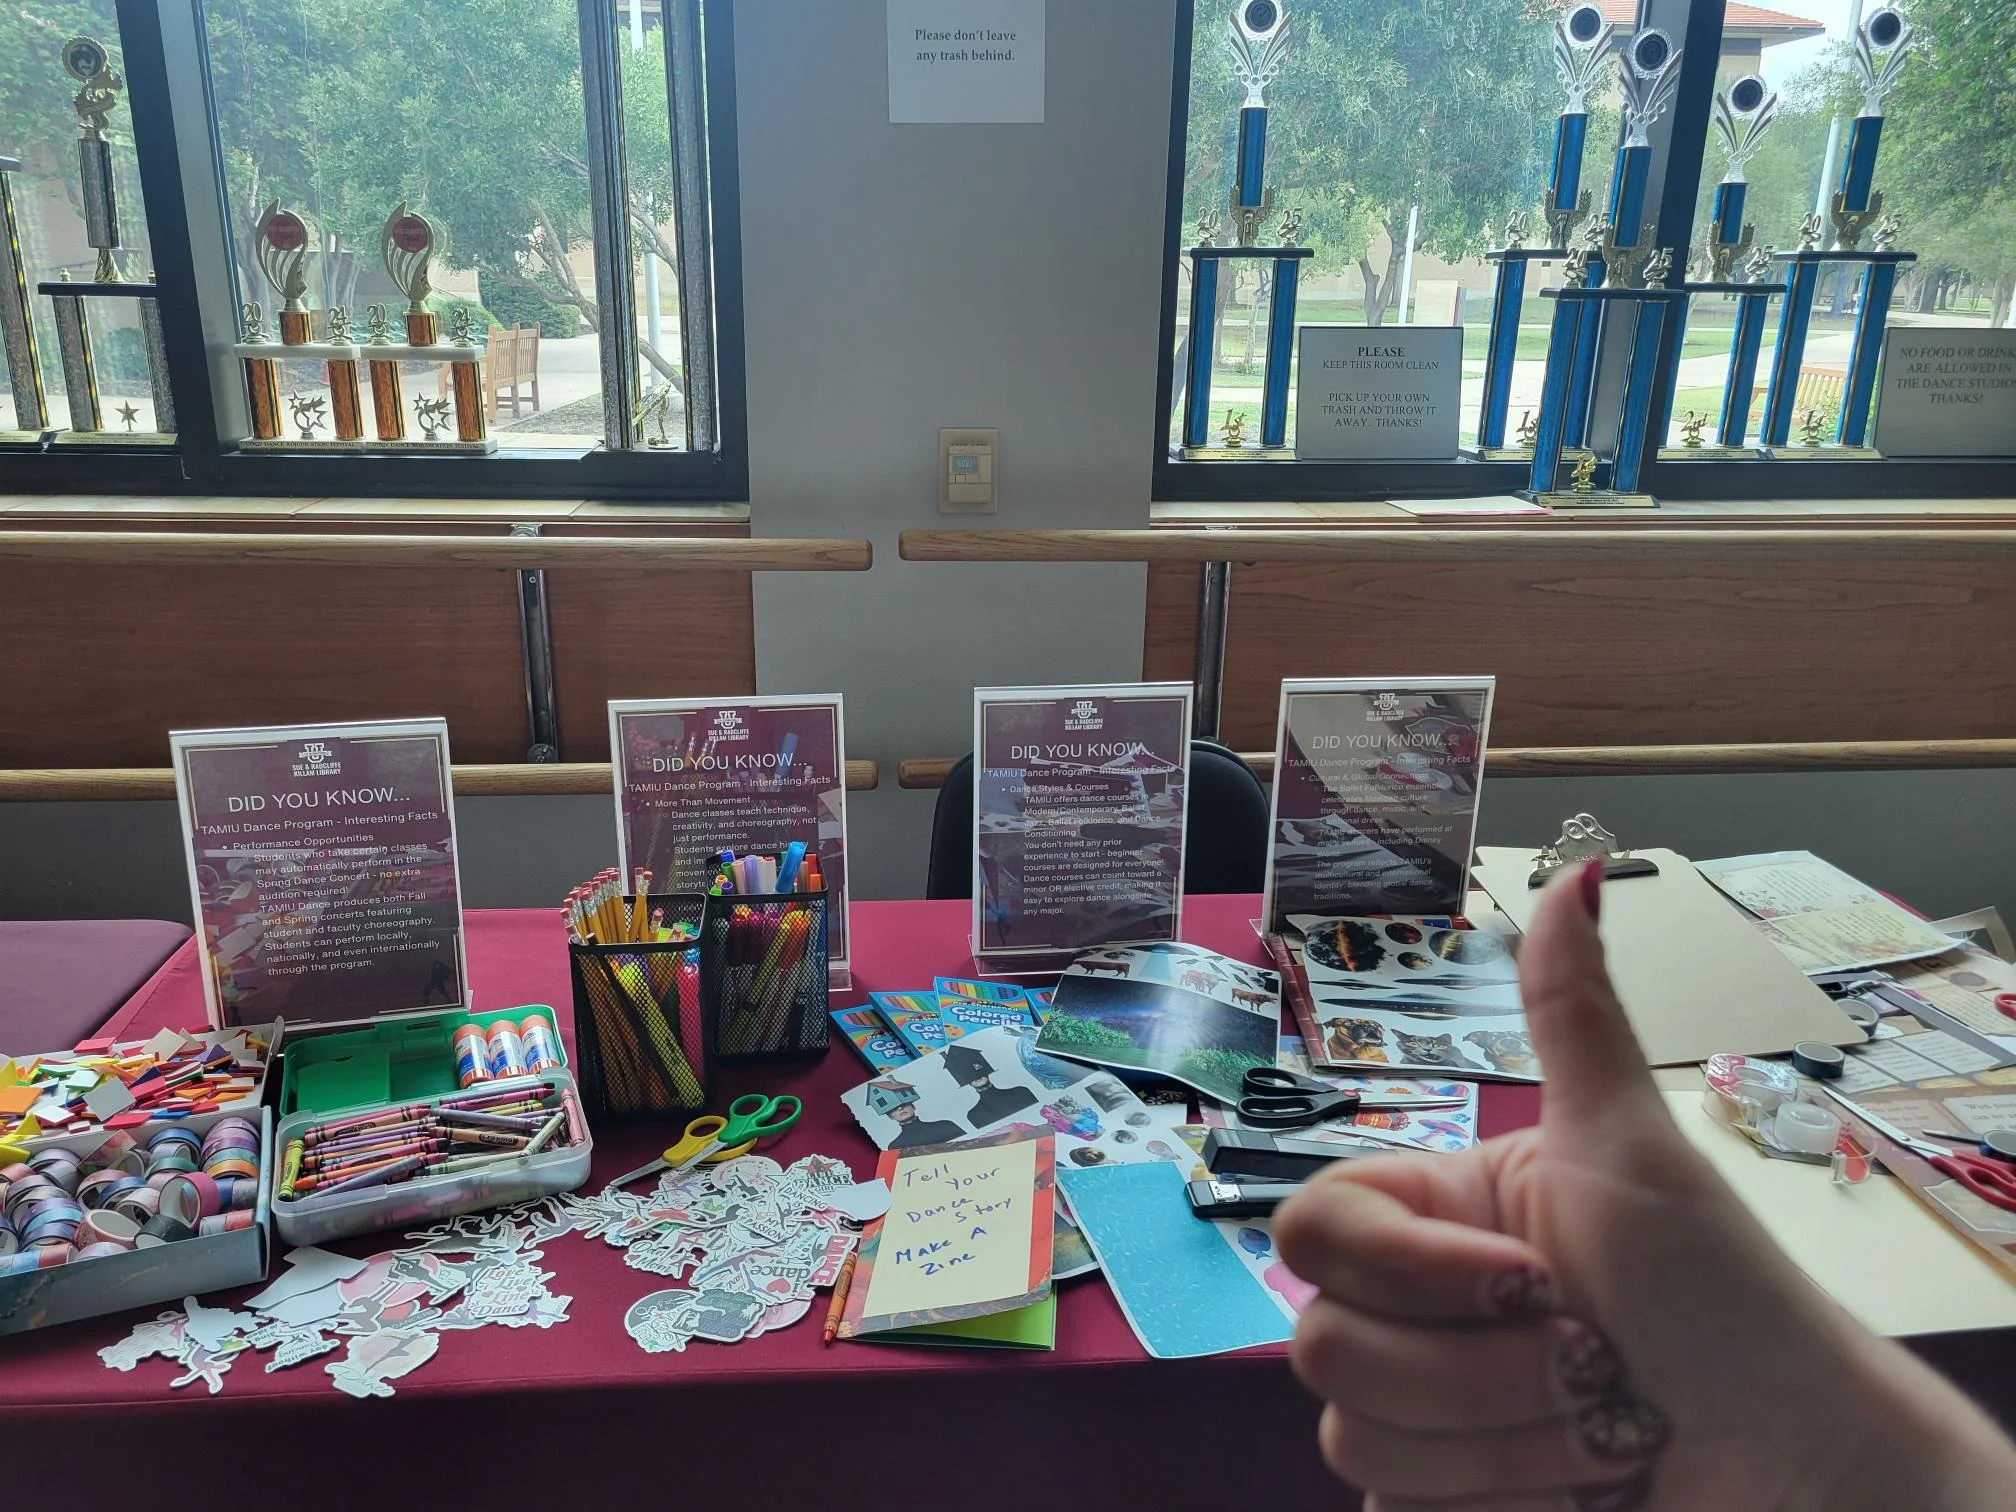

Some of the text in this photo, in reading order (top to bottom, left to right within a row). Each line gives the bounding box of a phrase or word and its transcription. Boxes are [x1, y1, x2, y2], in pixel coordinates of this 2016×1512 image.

[915, 29, 950, 41] Please
[987, 29, 1016, 41] leave
[917, 50, 1015, 63] any trash behind.
[243, 302, 263, 325] 20
[329, 305, 348, 327] 24
[367, 303, 387, 323] 20
[453, 307, 471, 327] 24
[1358, 347, 1406, 357] PLEASE
[1900, 347, 1917, 358] NO
[1920, 348, 1955, 358] FOOD
[1958, 348, 1974, 358] OR
[1323, 361, 1439, 370] KEEP THIS ROOM CLEAN
[1906, 363, 2012, 373] ARE ALLOWED IN
[1896, 378, 1921, 389] THE
[1922, 379, 1966, 389] DANCE
[1329, 393, 1430, 402] PICK UP YOUR OWN
[1322, 406, 1436, 415] TRASH AND THROW IT
[1334, 418, 1422, 428] AWAY. THANKS!
[1313, 736, 1340, 749] DID
[1347, 734, 1382, 748] YOU
[1011, 746, 1040, 759] DID
[1045, 744, 1082, 758] YOU
[653, 753, 807, 772] DID YOU KNOW...
[317, 768, 341, 776] LIBRARY
[629, 776, 831, 792] TAMIU Dance Program Interesting Facts
[228, 787, 410, 812] DID YOU KNOW...
[655, 796, 751, 808] More Than Movement
[200, 811, 437, 835] TAMIU Dance Program Interesting Facts
[718, 819, 735, 828] and
[803, 816, 816, 824] not
[233, 834, 374, 850] Performance Opportunities
[1024, 841, 1039, 849] You
[1103, 838, 1122, 847] prior
[256, 855, 422, 875] may automatically perform in the
[1073, 860, 1110, 870] designed
[257, 879, 291, 889] Spring
[294, 876, 327, 885] Dance
[330, 873, 370, 882] Concert
[395, 869, 421, 877] extra
[259, 887, 348, 901] audition required!
[260, 892, 426, 913] TAMIU Dance produces both Fall
[263, 929, 302, 938] student
[306, 926, 324, 935] and
[327, 922, 361, 933] faculty
[268, 959, 375, 976] through the program.
[951, 1007, 1021, 1022] Colored
[958, 1015, 1020, 1026] Pencils
[482, 1134, 513, 1143] Crayola
[903, 1164, 949, 1187] Tell
[784, 1185, 828, 1210] DANCING
[907, 1198, 974, 1223] Dance
[744, 1218, 784, 1240] PASSION
[765, 1217, 779, 1227] MY
[970, 1227, 987, 1240] A
[640, 1256, 672, 1272] Mom
[920, 1253, 976, 1276] Zine
[487, 1269, 524, 1280] Love
[750, 1265, 810, 1282] dance
[473, 1304, 529, 1316] Dance
